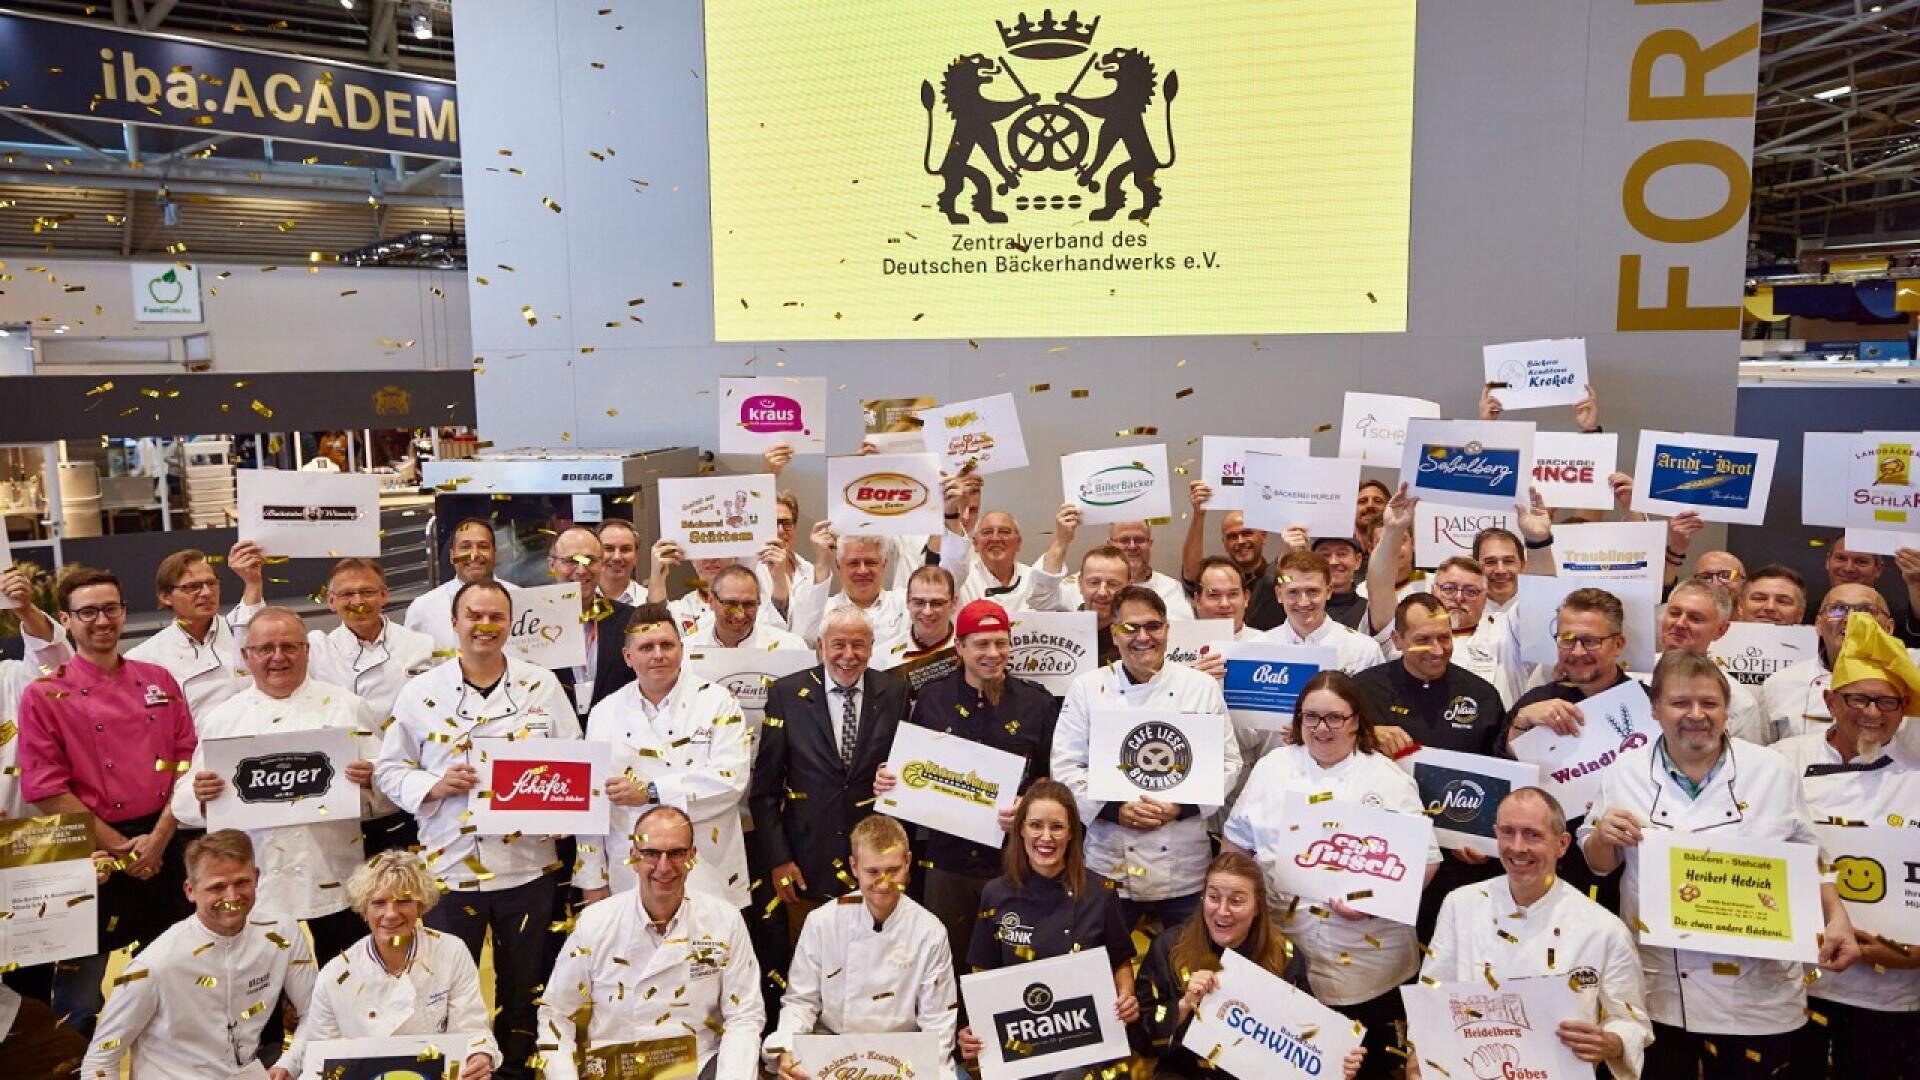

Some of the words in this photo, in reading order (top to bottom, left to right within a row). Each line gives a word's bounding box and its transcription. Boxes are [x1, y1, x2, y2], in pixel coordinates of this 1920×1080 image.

[1617, 0, 1761, 332] FOR
[951, 231, 1104, 251] Zentralverband
[1112, 230, 1148, 249] des
[882, 256, 988, 276] Deutschen
[995, 252, 1176, 274] Bäckerhandwerks
[1184, 251, 1221, 270] e.V.
[749, 407, 795, 421] kraus
[857, 487, 913, 501] Bors
[1433, 515, 1507, 546] RAISCH
[1253, 664, 1289, 685] Bals
[248, 767, 322, 791] Rager
[1730, 873, 1772, 890] Hedrich
[1226, 1007, 1322, 1077] SCHWIND
